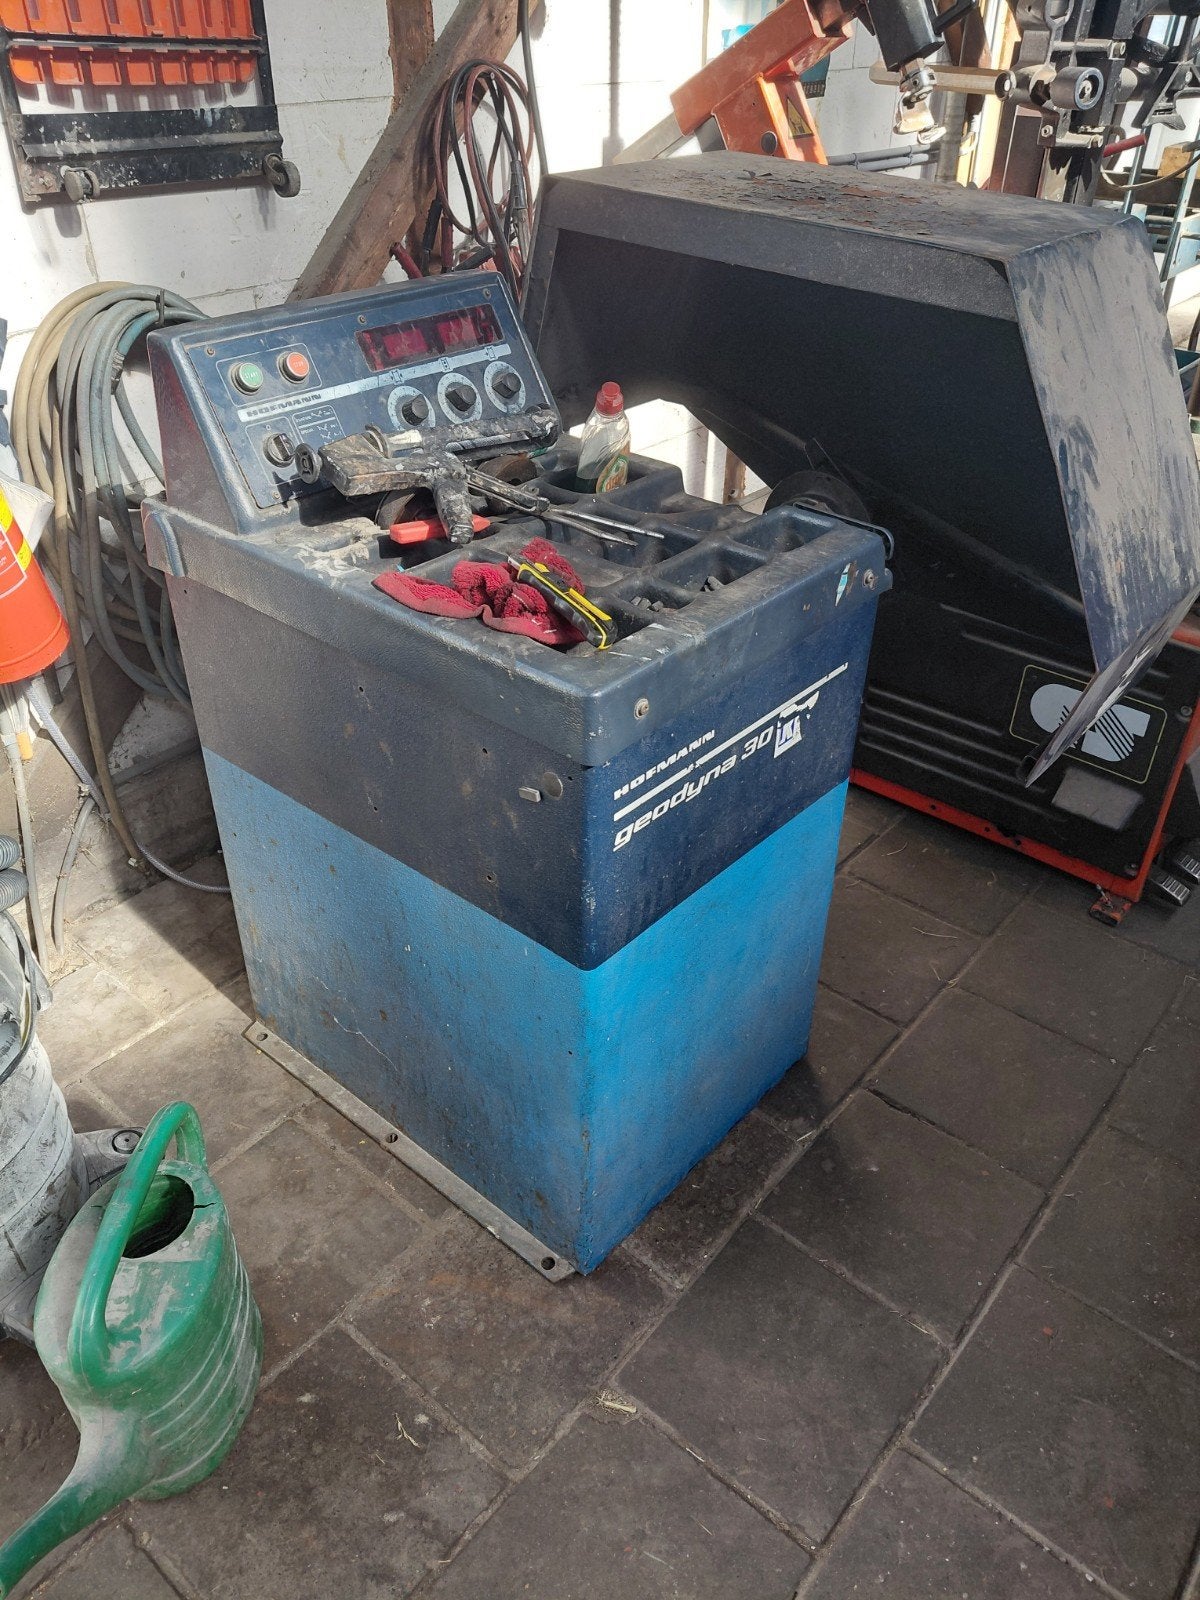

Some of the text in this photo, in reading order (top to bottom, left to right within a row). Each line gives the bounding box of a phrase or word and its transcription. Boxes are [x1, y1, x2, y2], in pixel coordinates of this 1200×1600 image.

[244, 371, 258, 379] START
[246, 394, 322, 417] HOFMANN
[613, 729, 716, 801] HOFMANN
[612, 754, 737, 853] geodyna
[741, 725, 774, 760] 30
